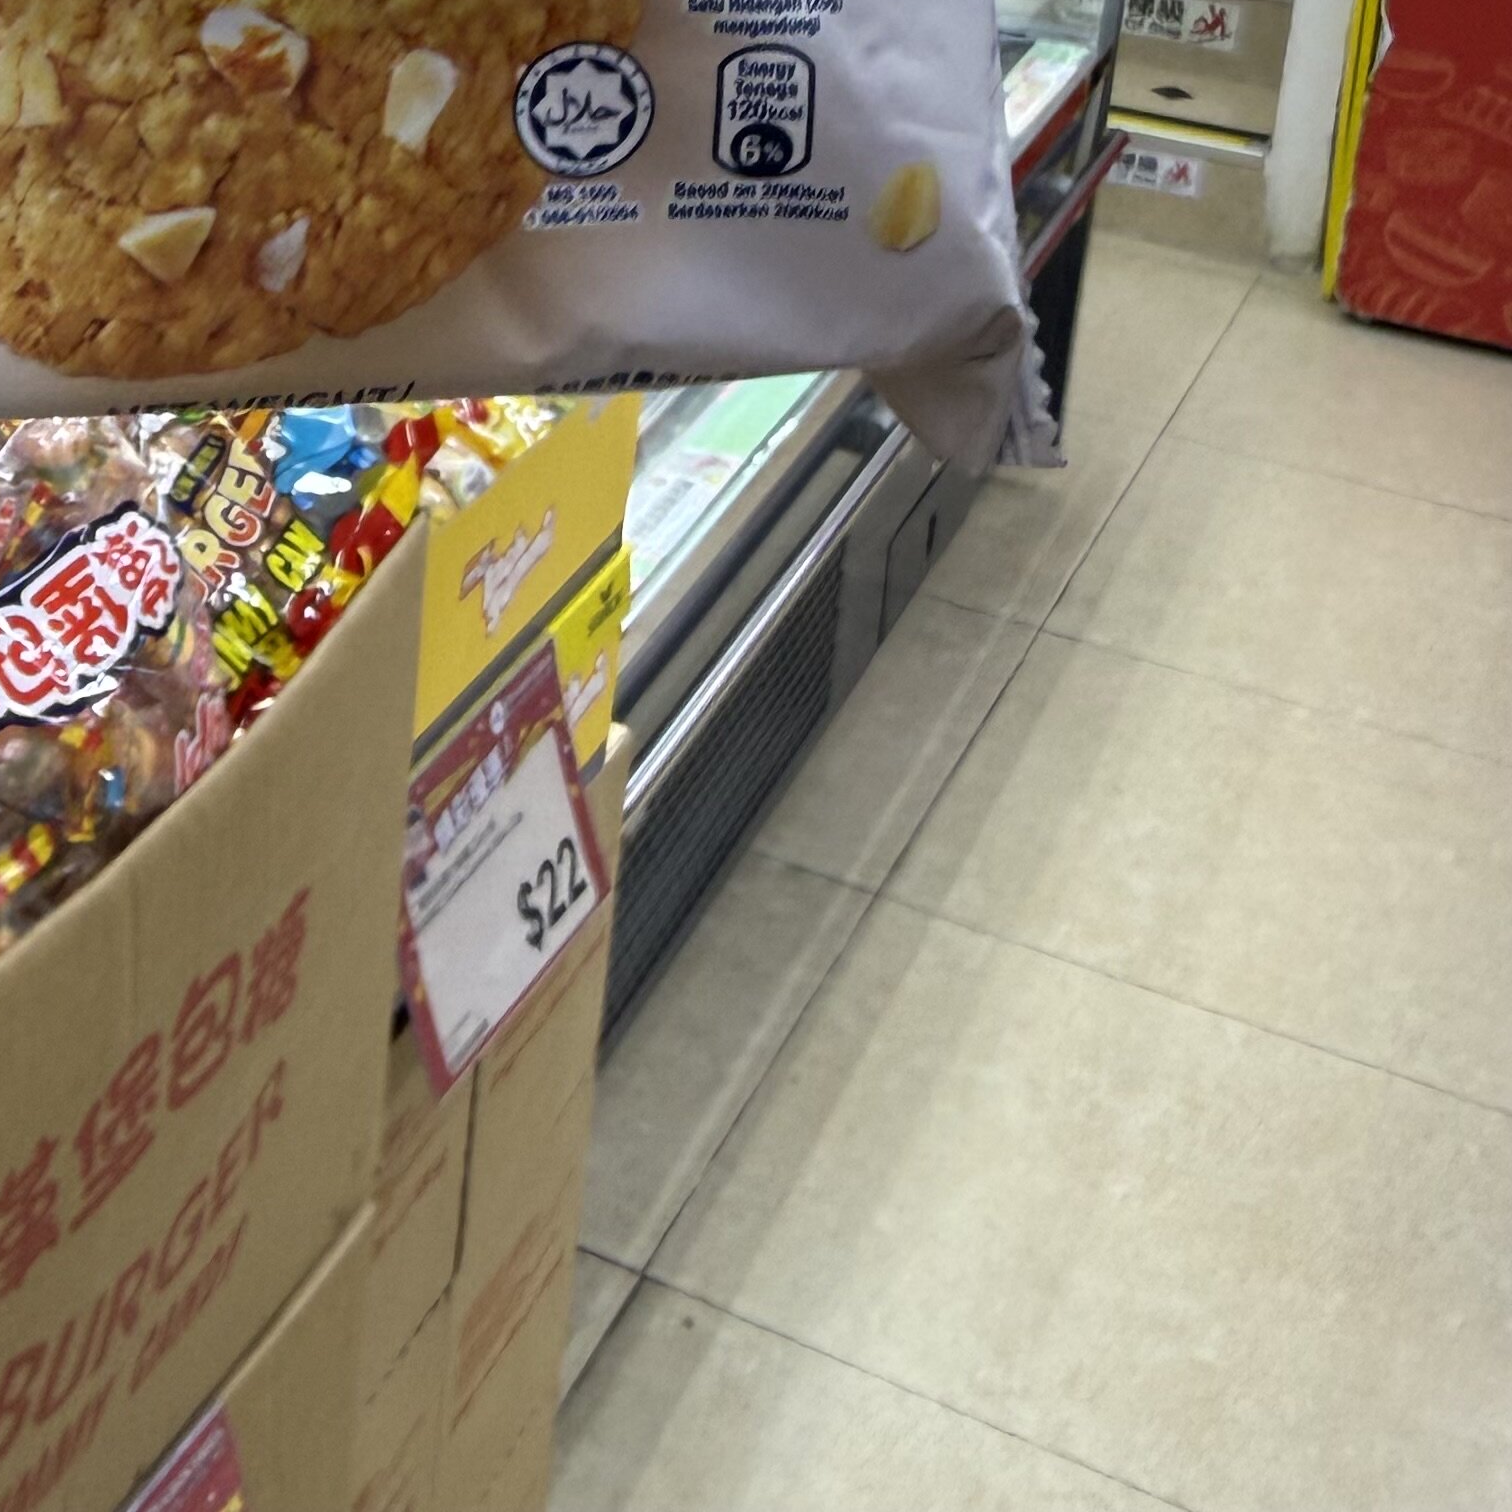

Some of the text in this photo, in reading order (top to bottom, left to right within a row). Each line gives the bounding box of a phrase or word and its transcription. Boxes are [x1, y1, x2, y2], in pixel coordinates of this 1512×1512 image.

[738, 59, 796, 81] Energy
[735, 80, 798, 101] Tenaga
[739, 134, 785, 168] 6%
[517, 837, 588, 953] $22
